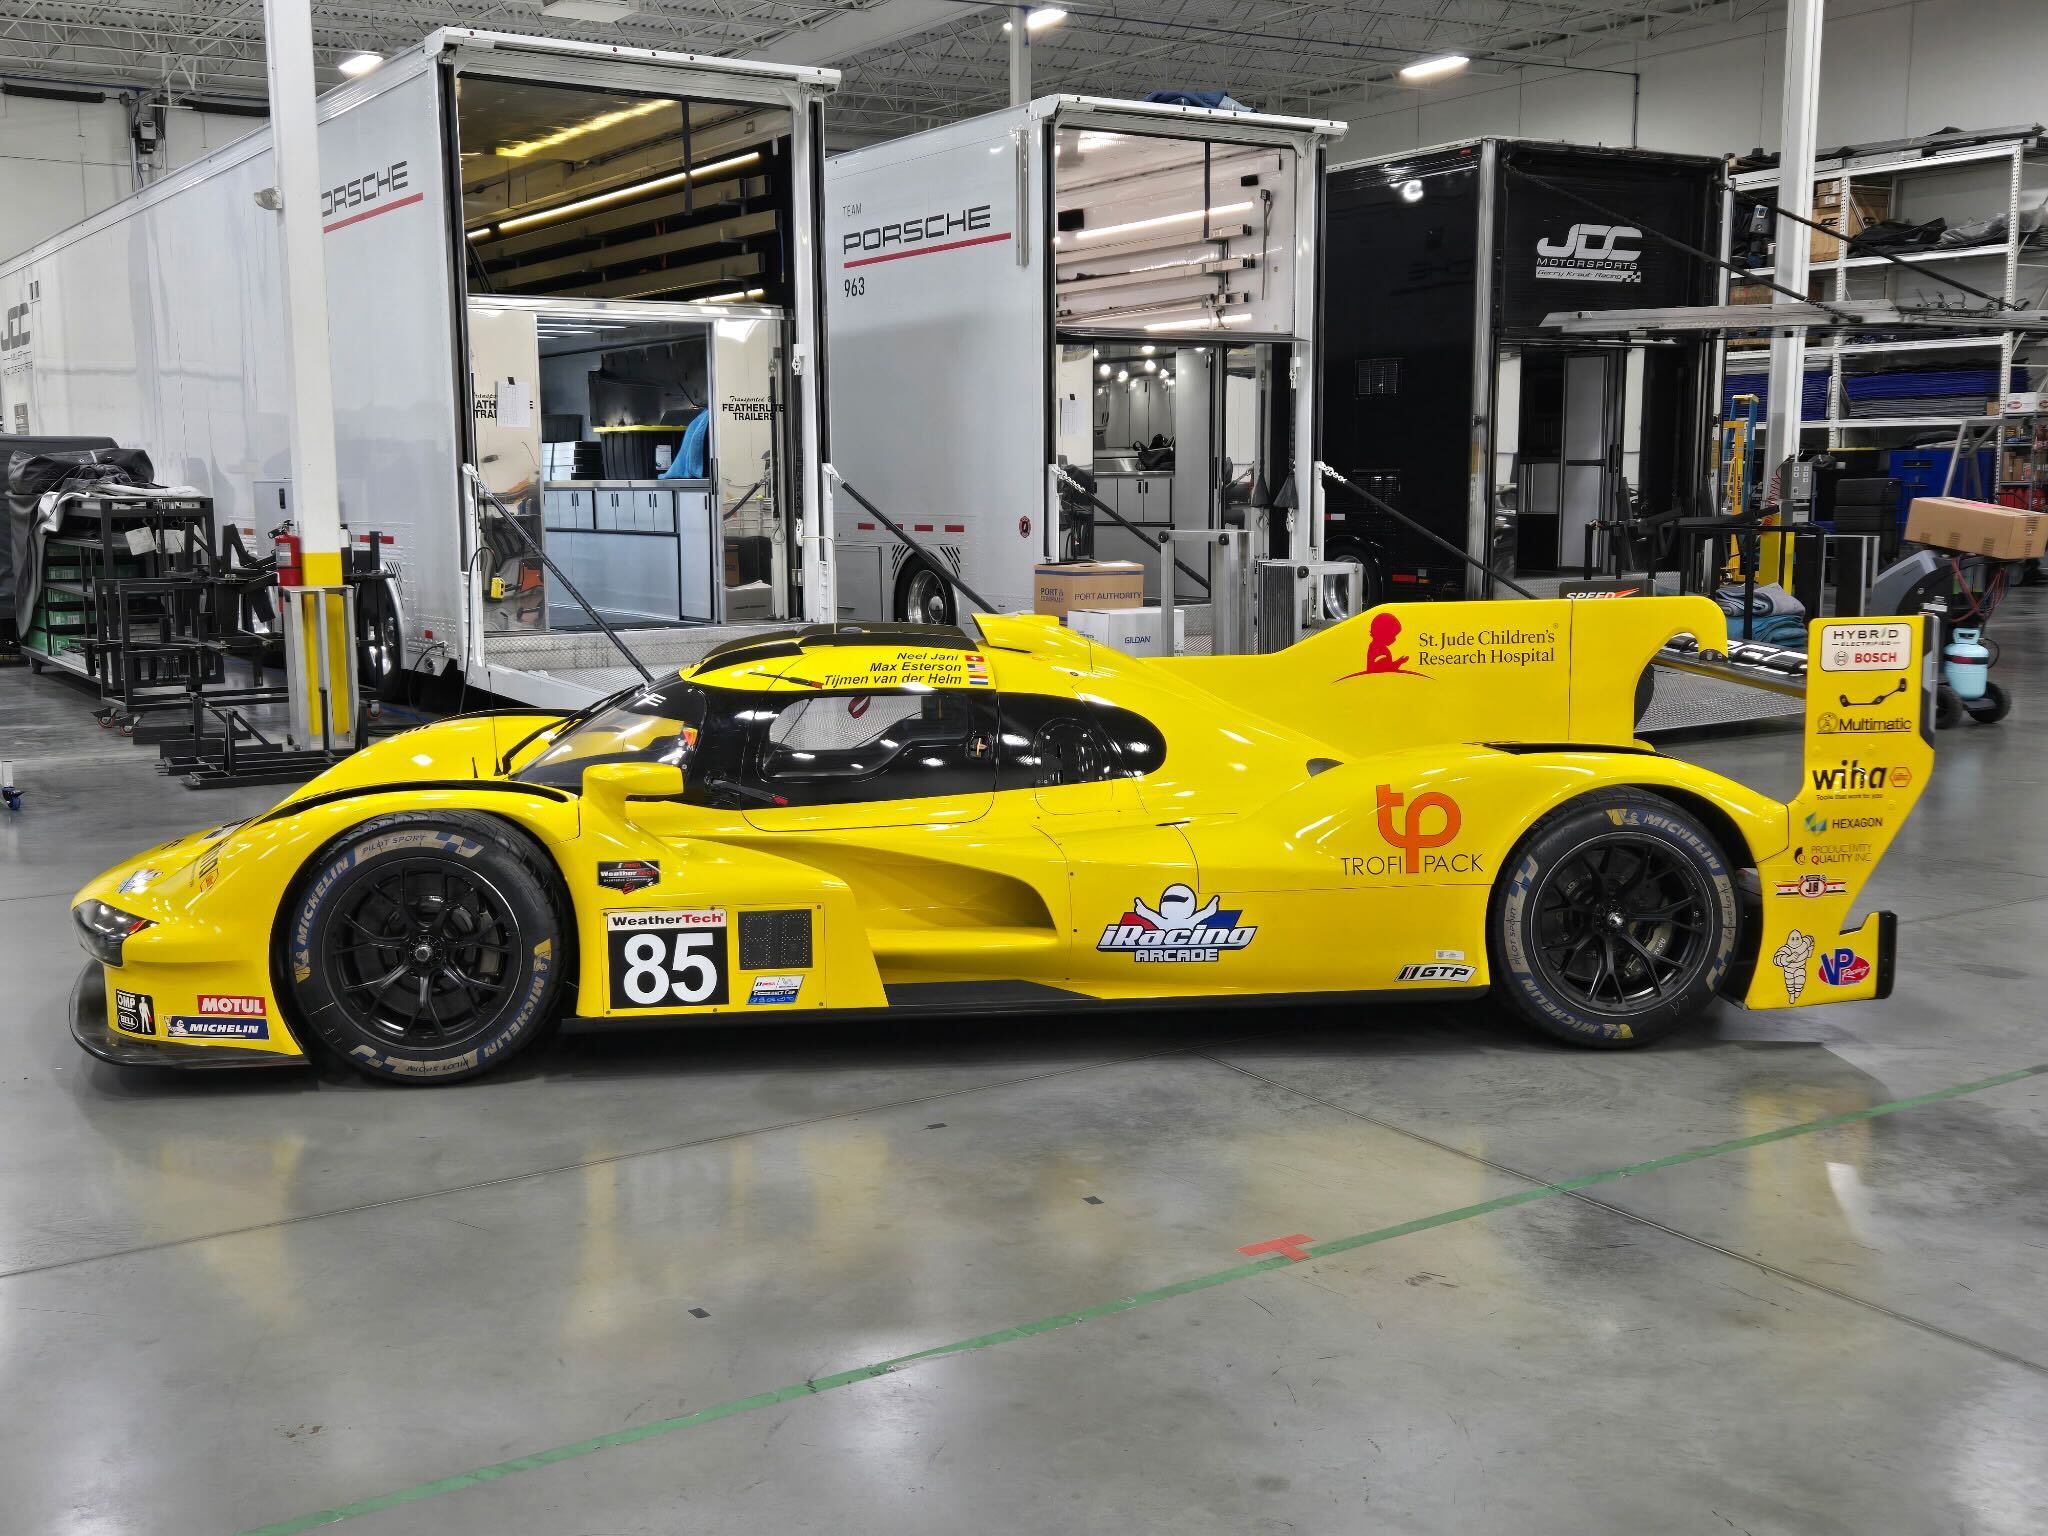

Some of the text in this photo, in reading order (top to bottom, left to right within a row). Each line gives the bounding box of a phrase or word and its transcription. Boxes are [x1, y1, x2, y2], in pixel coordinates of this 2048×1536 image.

[321, 160, 408, 217] ORSCHE
[843, 203, 861, 216] TEAM
[844, 205, 990, 255] PORSCHE
[1537, 223, 1642, 261] JDC
[1537, 258, 1637, 270] MOTORSPORTS
[1537, 269, 1563, 277] Gerry
[1595, 272, 1623, 280] Racing
[844, 277, 865, 297] 963
[733, 412, 775, 421] TRAILERS
[1040, 587, 1058, 595] PORT
[1097, 592, 1142, 600] AUTHORITY
[1124, 635, 1151, 644] GILDAN
[1419, 632, 1438, 646] St.
[1440, 631, 1474, 650] Jude
[897, 652, 959, 661] Neel Jani
[1419, 648, 1555, 666] Research Hospital
[1854, 652, 1897, 663] BOSCH
[870, 662, 962, 672] Max Esterson
[824, 673, 962, 688] Tijmen van der Helm
[1839, 717, 1912, 731] Multimatic
[1812, 759, 1888, 790] wiha
[1832, 817, 1883, 829] HEXAGON
[362, 833, 427, 855] PILOT SPORT
[1644, 814, 1721, 870] MICHELIN
[1340, 853, 1484, 876] TROFI PACK
[1811, 854, 1853, 865] QUALITY
[297, 856, 350, 946] MICHELIN
[612, 913, 722, 926] WeatherTech
[1100, 924, 1258, 946] iRacing
[1135, 948, 1218, 962] ARCADE
[624, 932, 718, 1004] 85
[1420, 966, 1470, 978] GTP
[1820, 947, 1855, 986] VP
[118, 995, 136, 1009] OMP
[201, 997, 264, 1014] MOTUL
[1521, 977, 1600, 1034] MICHELIN
[120, 1014, 136, 1026] BELL
[484, 976, 546, 1059] MICHELIN
[189, 1023, 259, 1034] MICHELIN
